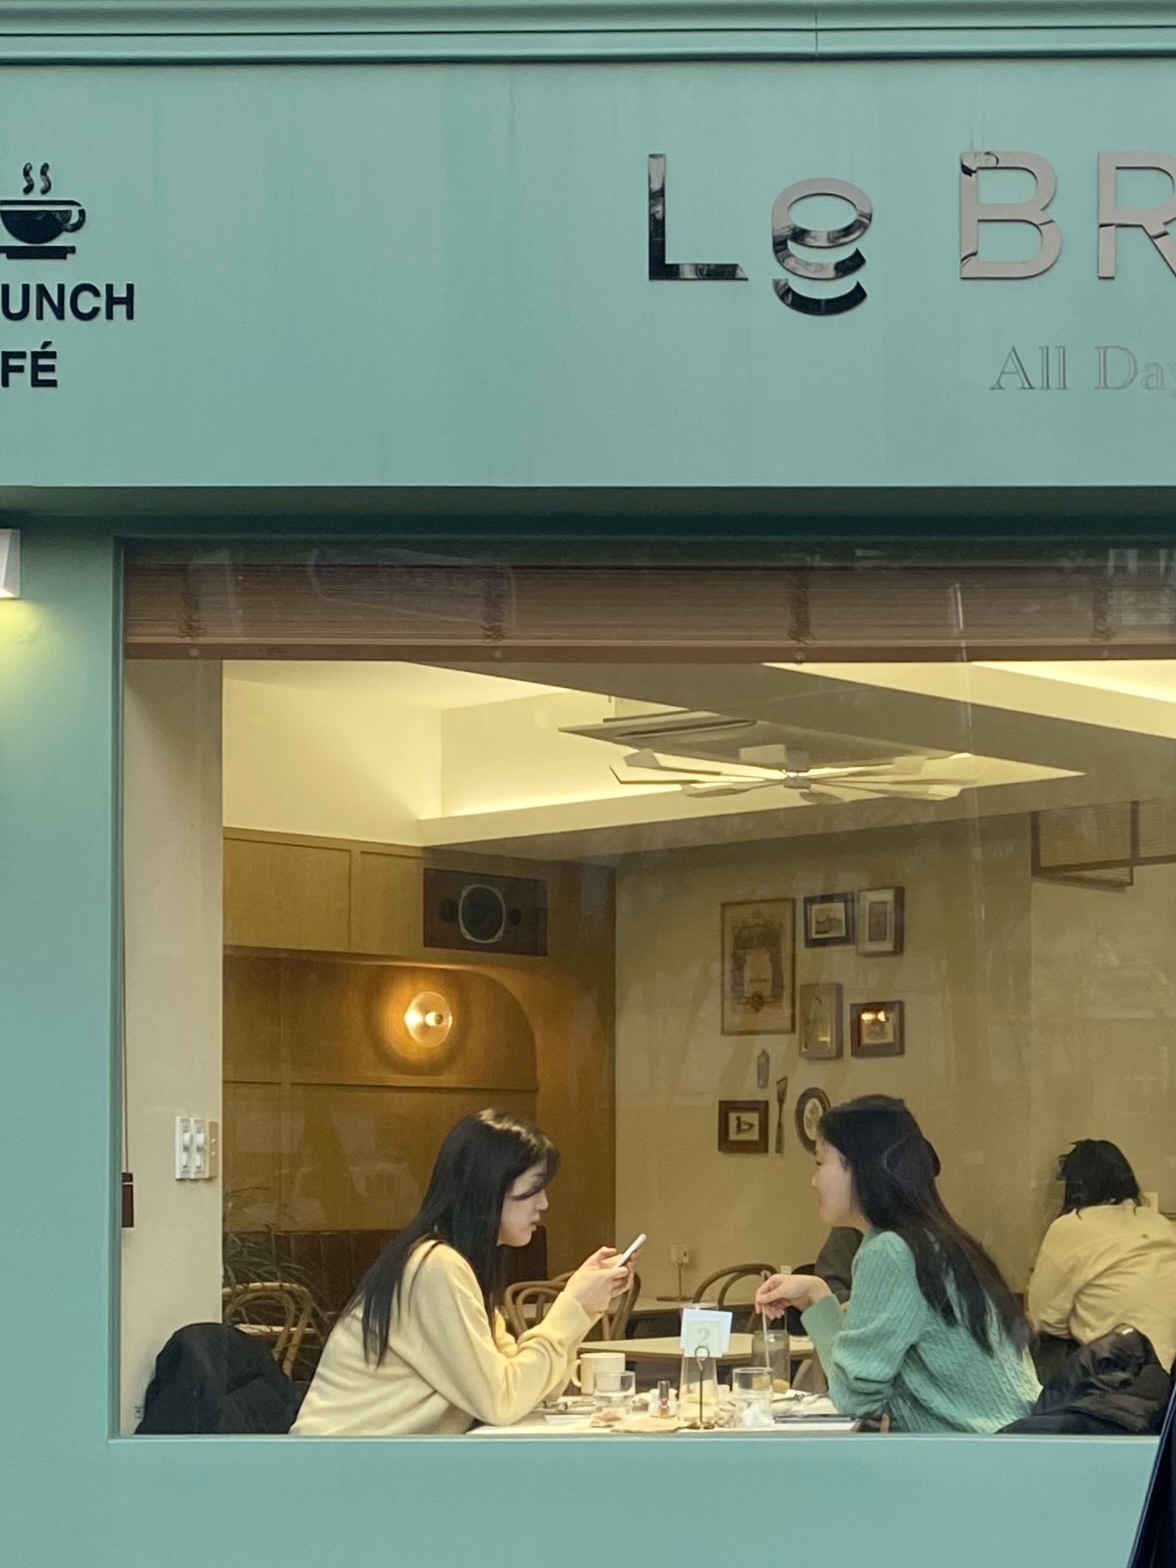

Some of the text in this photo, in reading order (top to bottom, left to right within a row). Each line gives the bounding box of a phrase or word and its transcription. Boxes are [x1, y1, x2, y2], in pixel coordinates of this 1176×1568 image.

[648, 153, 874, 317] Le
[1, 282, 136, 322] UNCH
[1, 340, 59, 388] FÉ
[989, 345, 1070, 391] All
